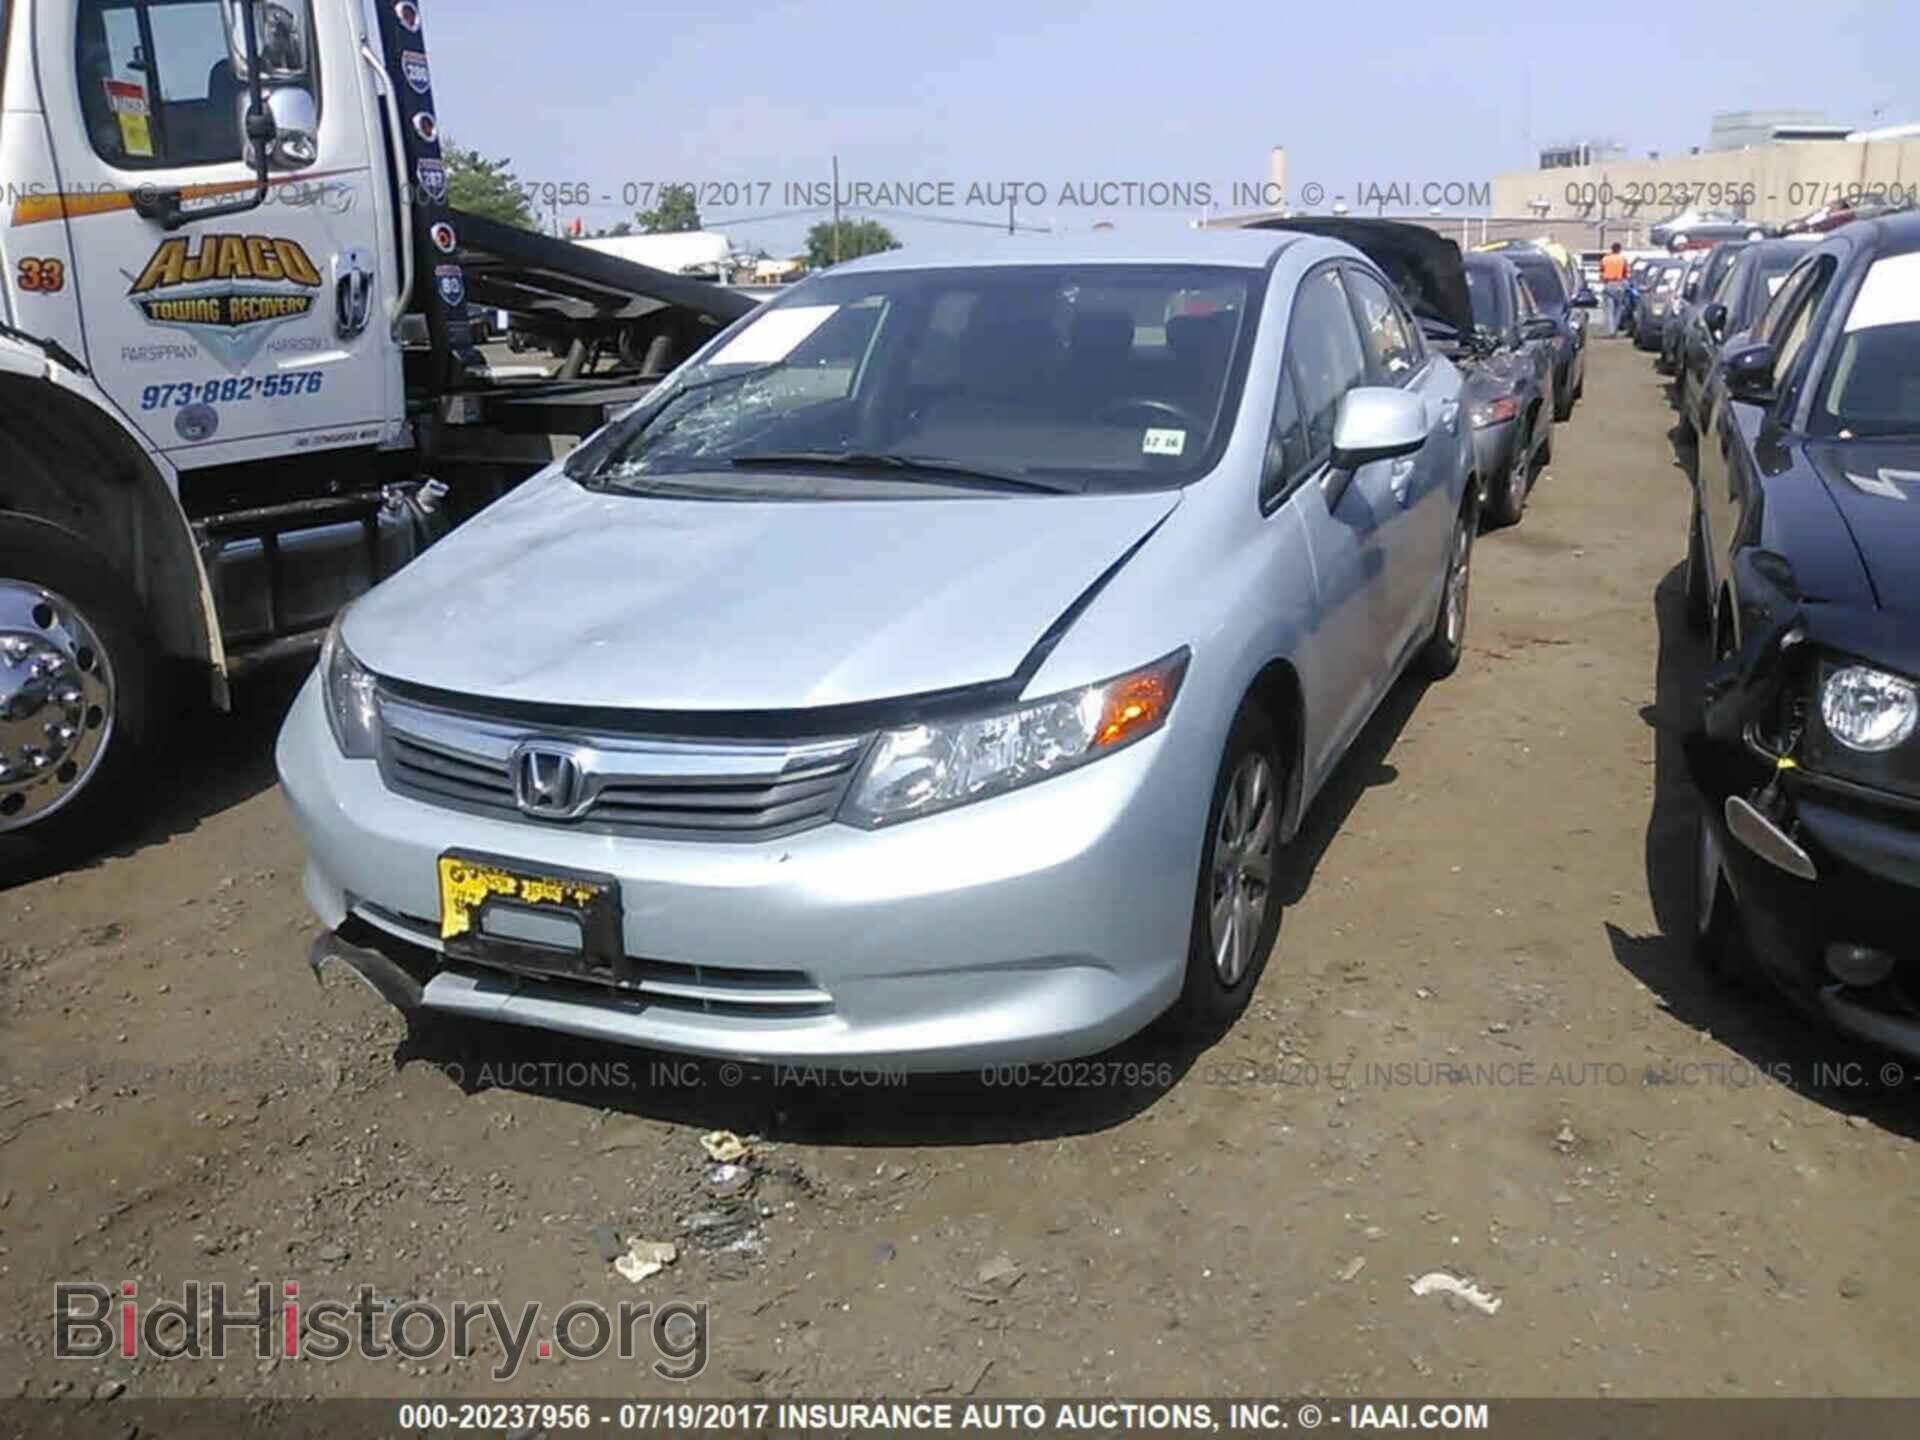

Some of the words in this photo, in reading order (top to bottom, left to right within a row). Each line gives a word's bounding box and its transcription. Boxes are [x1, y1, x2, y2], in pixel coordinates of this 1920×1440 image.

[17, 257, 64, 292] 33
[128, 234, 322, 295] AJACO
[150, 299, 220, 321] TOWING
[230, 298, 308, 321] RECOVERY
